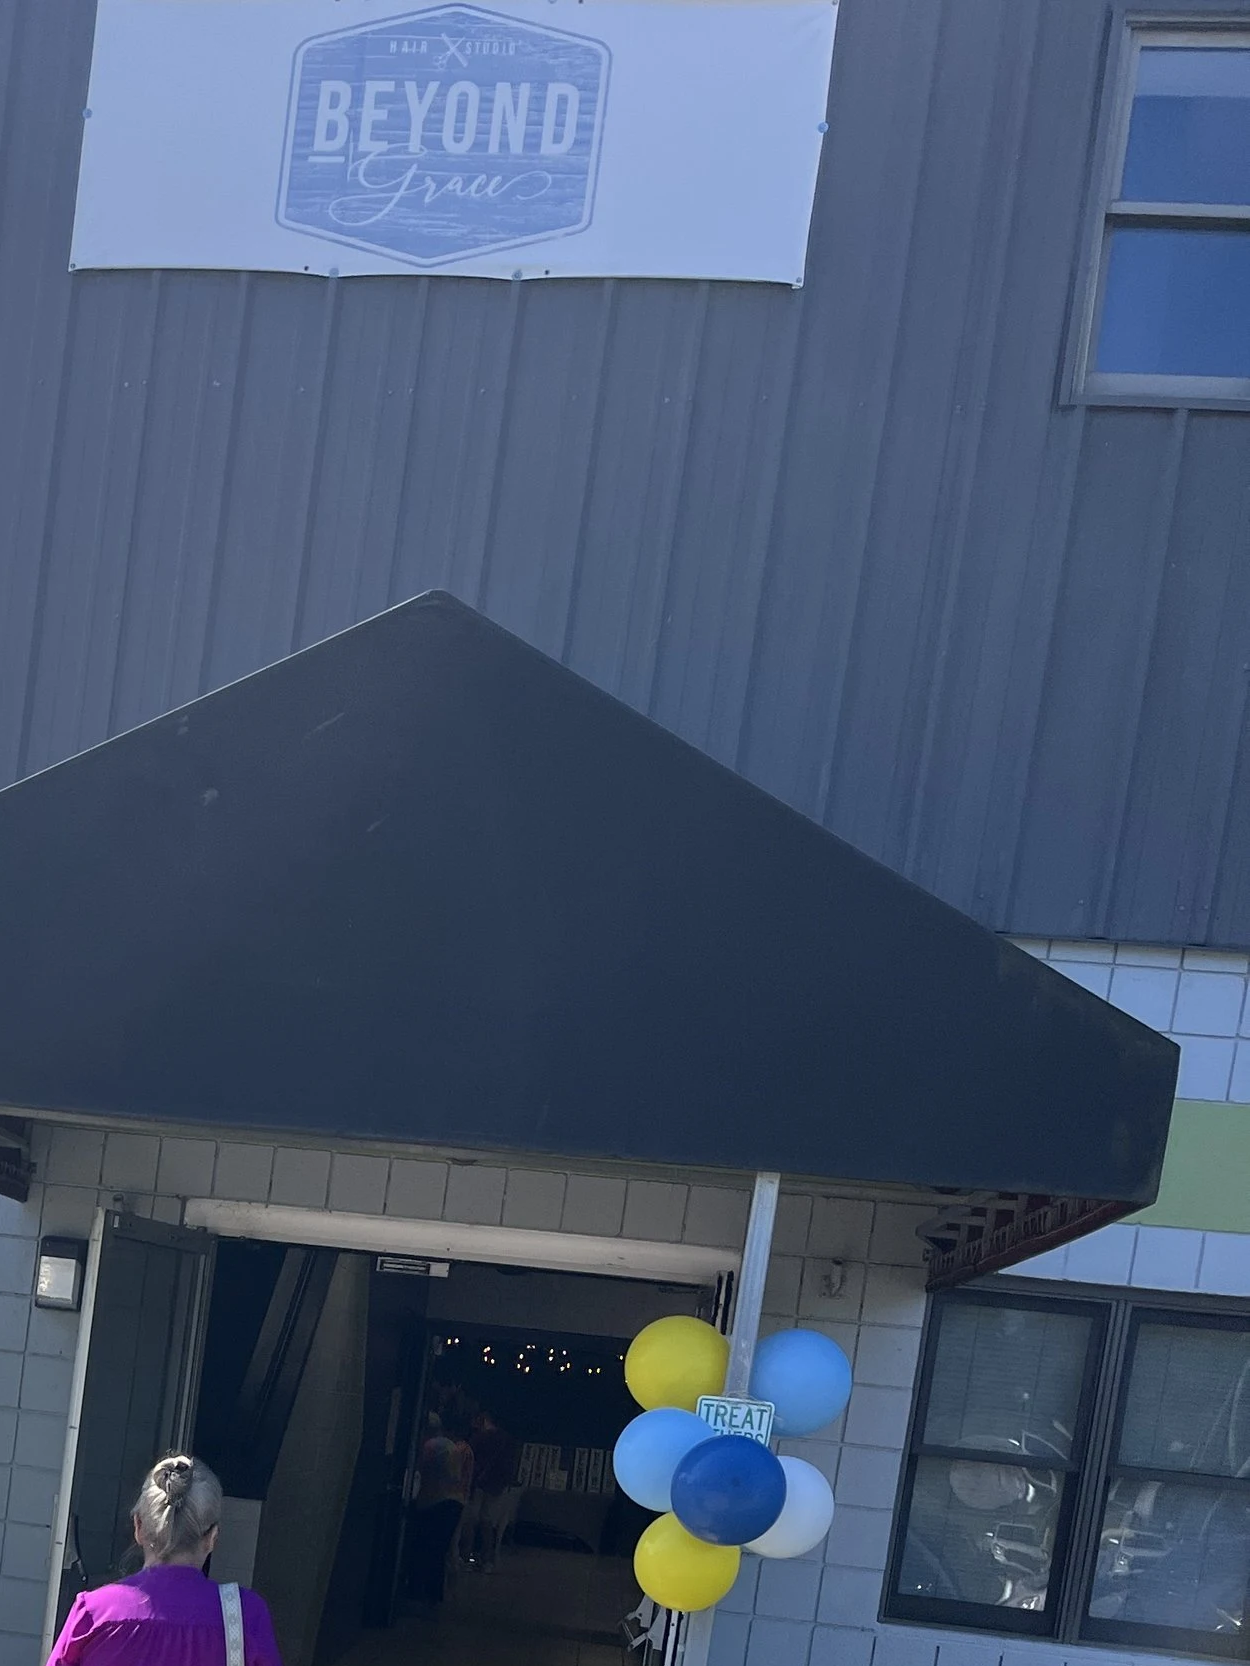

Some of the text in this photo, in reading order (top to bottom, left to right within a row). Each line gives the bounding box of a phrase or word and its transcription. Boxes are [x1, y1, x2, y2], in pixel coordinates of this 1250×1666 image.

[389, 40, 517, 56] HAIR STUDIO
[313, 80, 581, 155] BEYOND
[328, 143, 551, 225] Grace
[703, 1403, 768, 1431] TREAT
